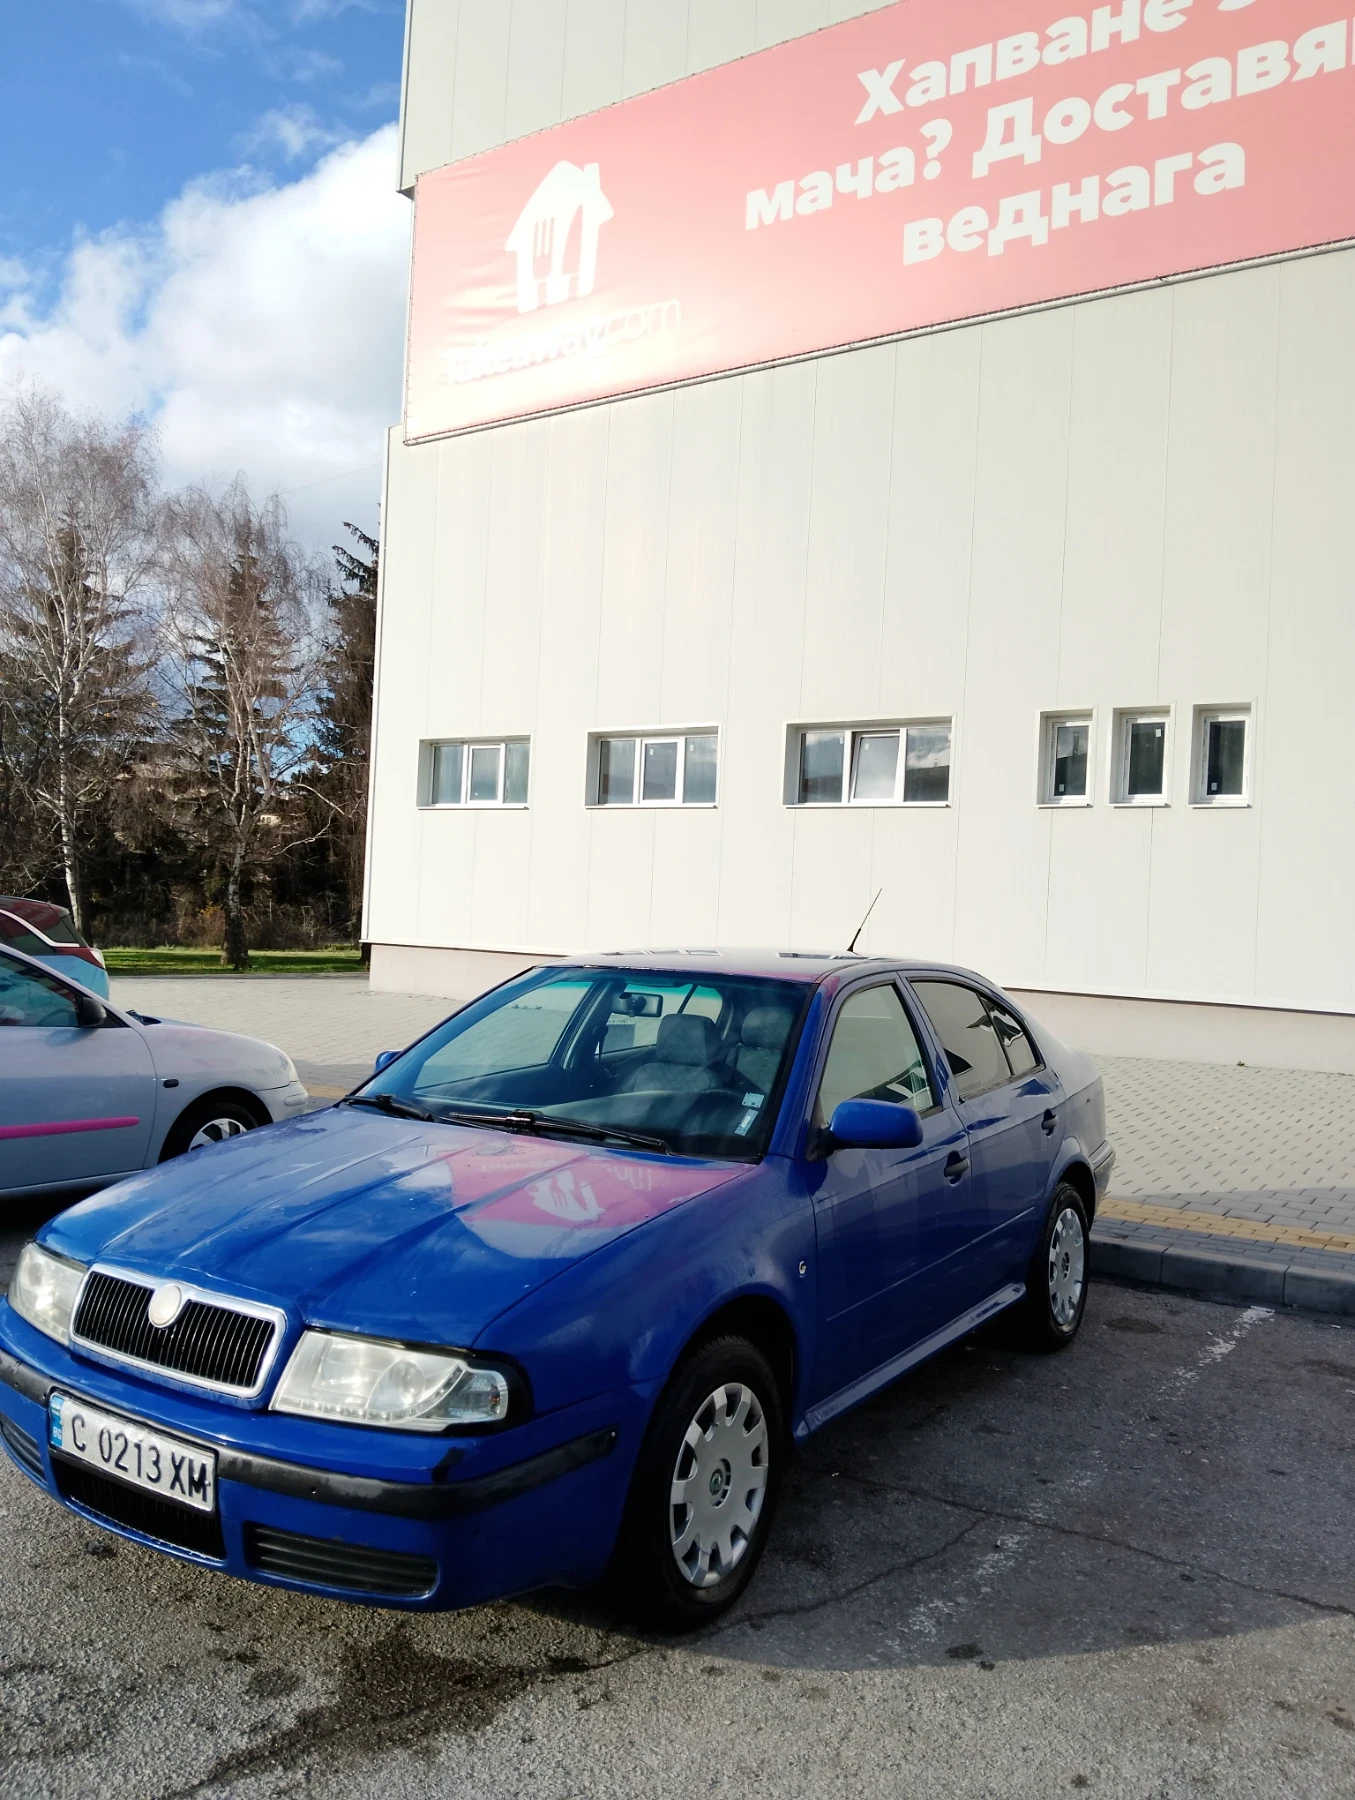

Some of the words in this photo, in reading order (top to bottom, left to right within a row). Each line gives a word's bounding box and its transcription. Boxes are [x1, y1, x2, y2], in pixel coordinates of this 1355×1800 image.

[744, 118, 953, 231] мача?
[972, 16, 1355, 179] Доставя
[854, 0, 1194, 125] Хапване
[902, 141, 1246, 266] веднага
[71, 1413, 87, 1452] C
[98, 1425, 163, 1484] 0213
[169, 1451, 211, 1503] XM
